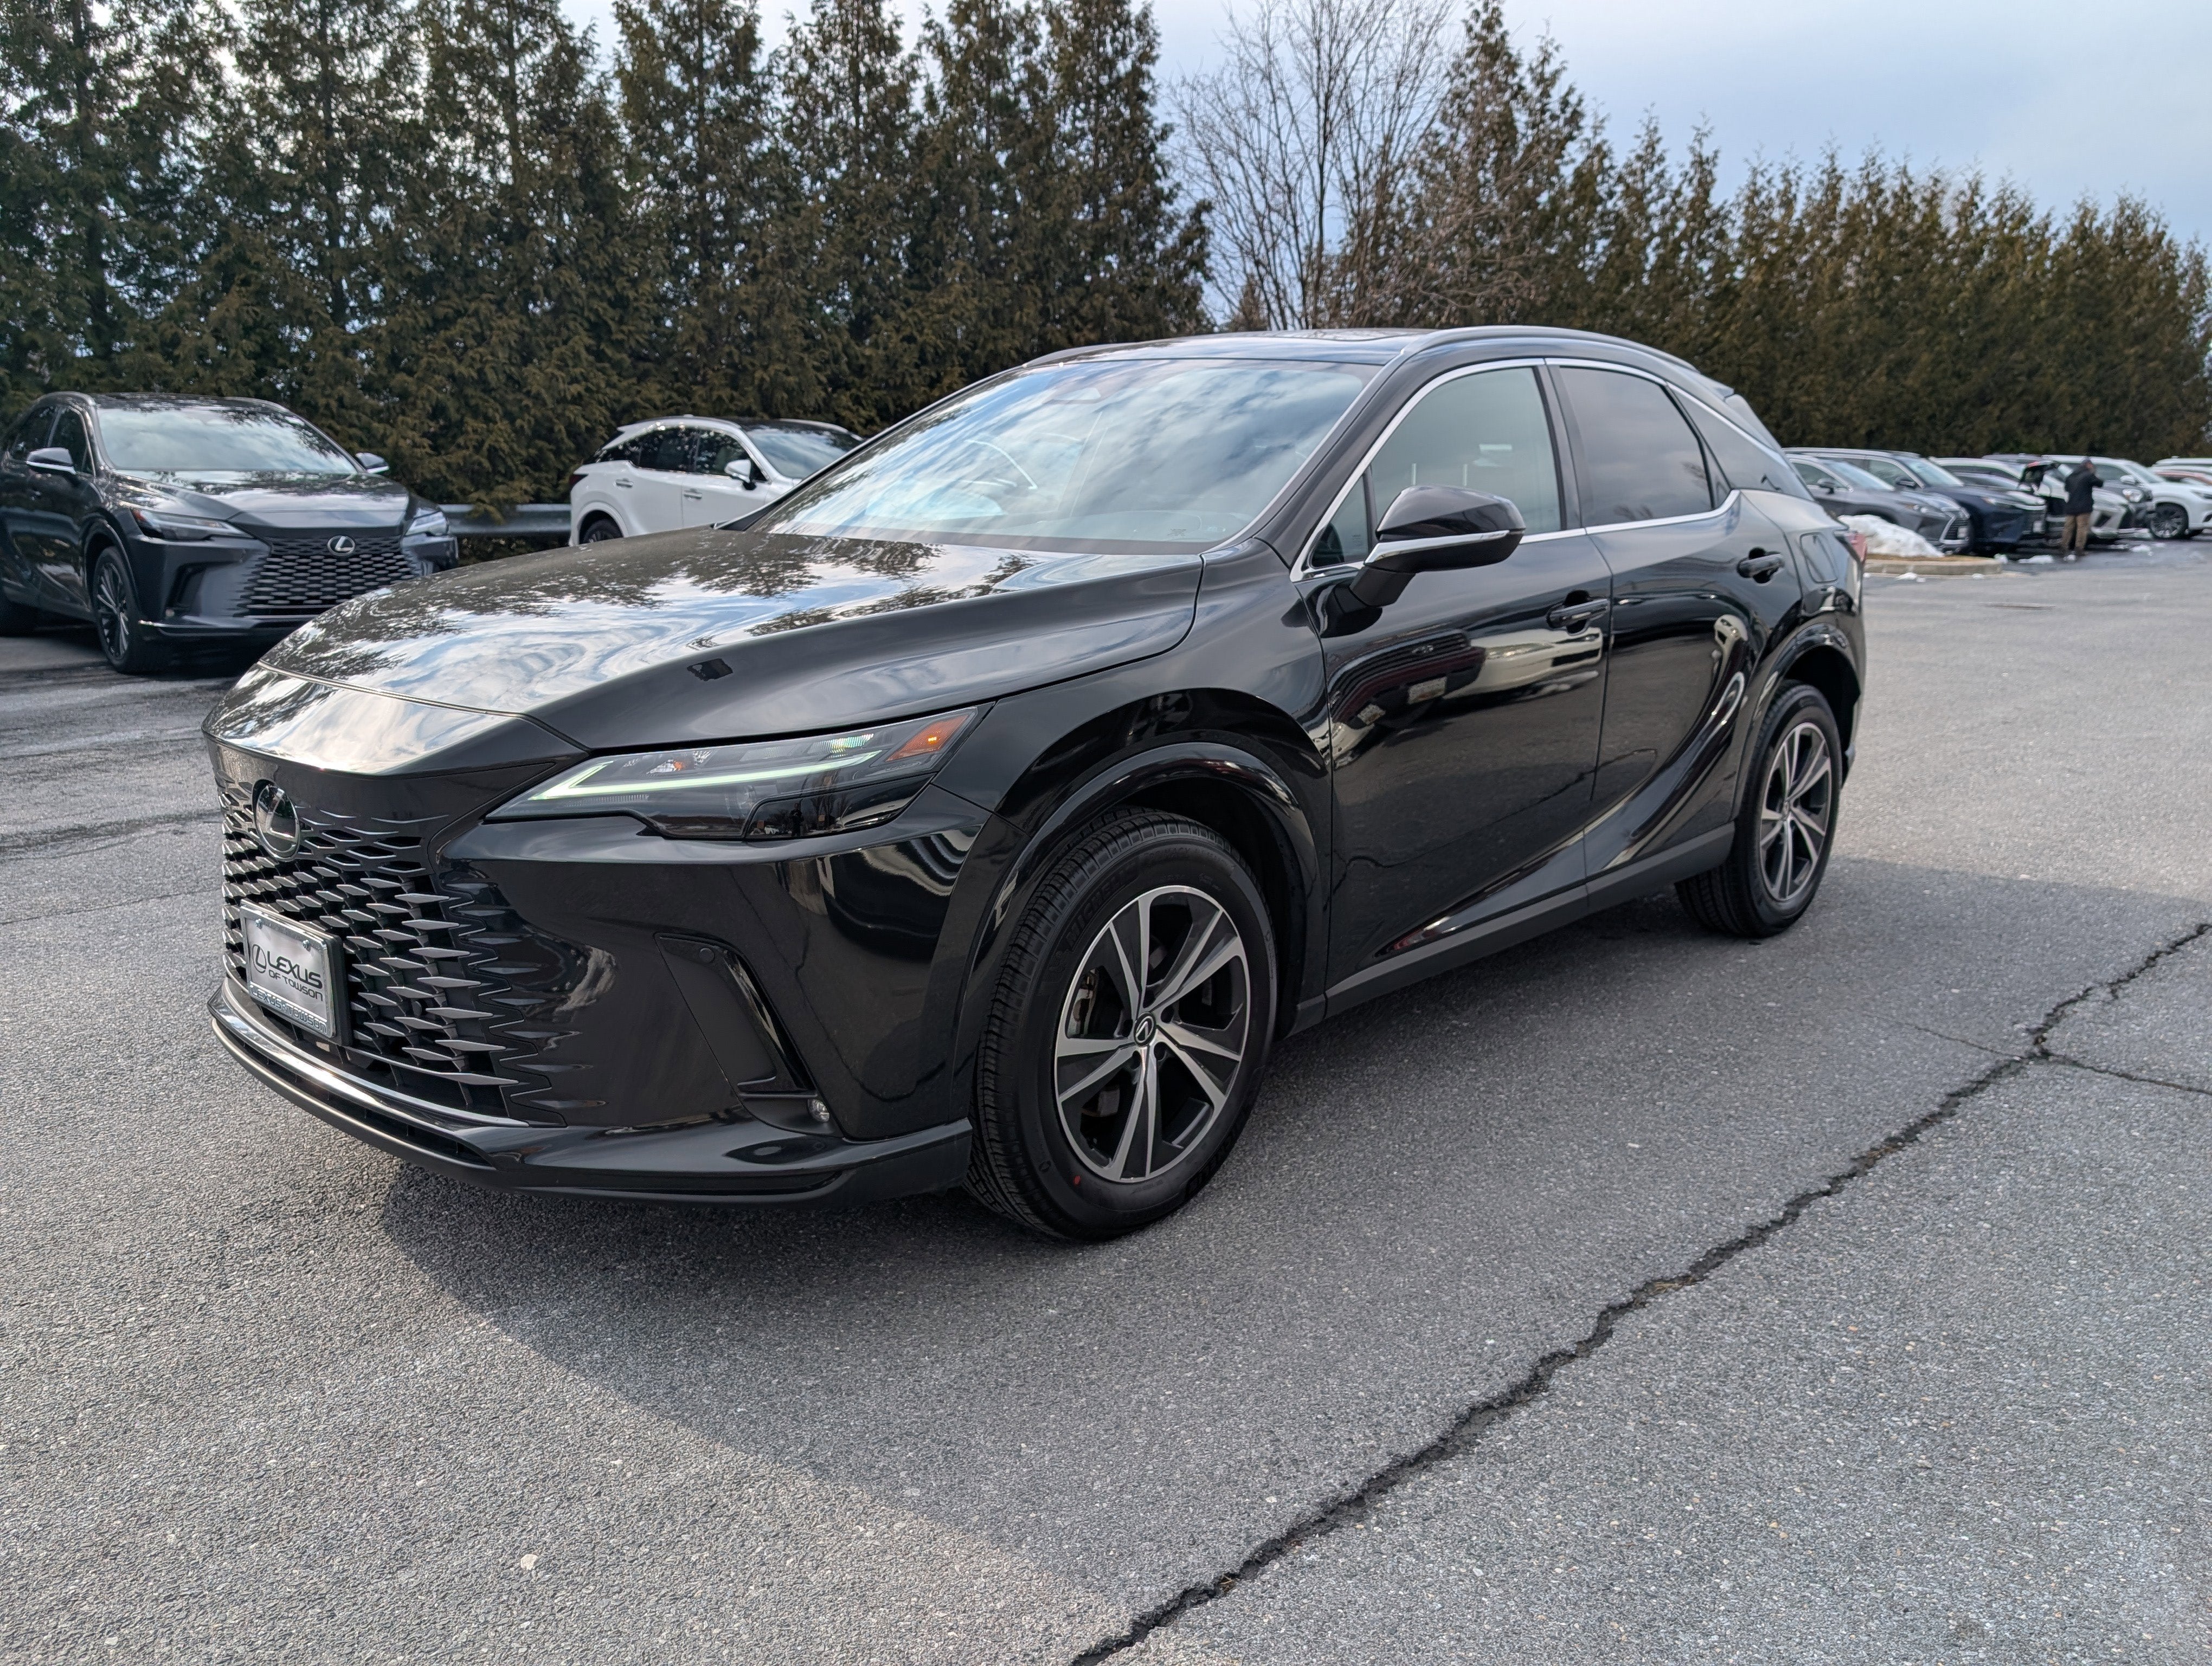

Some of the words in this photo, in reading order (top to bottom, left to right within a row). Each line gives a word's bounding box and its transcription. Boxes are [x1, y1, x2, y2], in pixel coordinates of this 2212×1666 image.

[267, 951, 323, 989] LEXUS
[268, 969, 281, 980] OF
[282, 975, 323, 1001] TOWSON
[251, 987, 281, 1009] LEXUS
[286, 1003, 327, 1034] TOWSON
